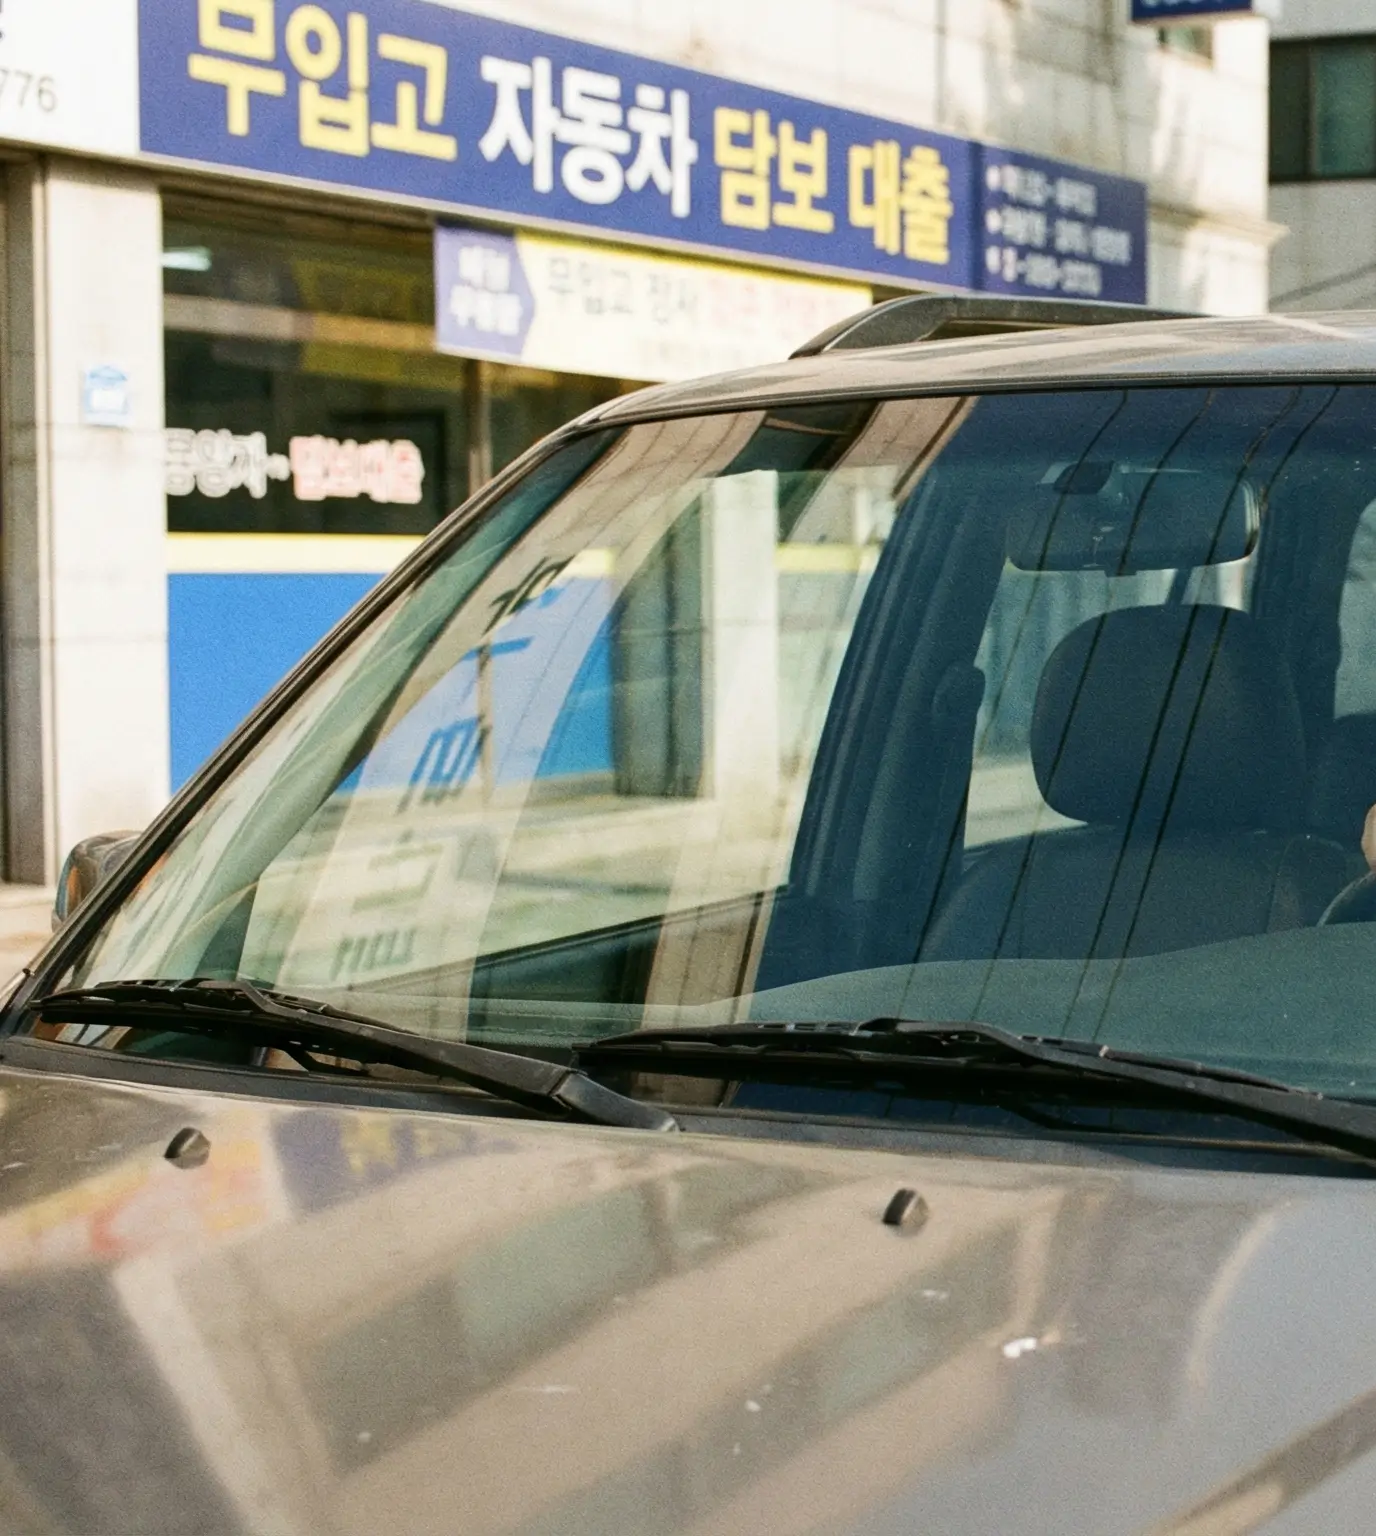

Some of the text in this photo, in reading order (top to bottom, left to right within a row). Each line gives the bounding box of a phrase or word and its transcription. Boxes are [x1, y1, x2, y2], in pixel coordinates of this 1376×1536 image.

[188, 0, 457, 160] 무입고
[479, 56, 698, 217] 자동차
[714, 107, 833, 233] 담보
[849, 141, 952, 264] 대출
